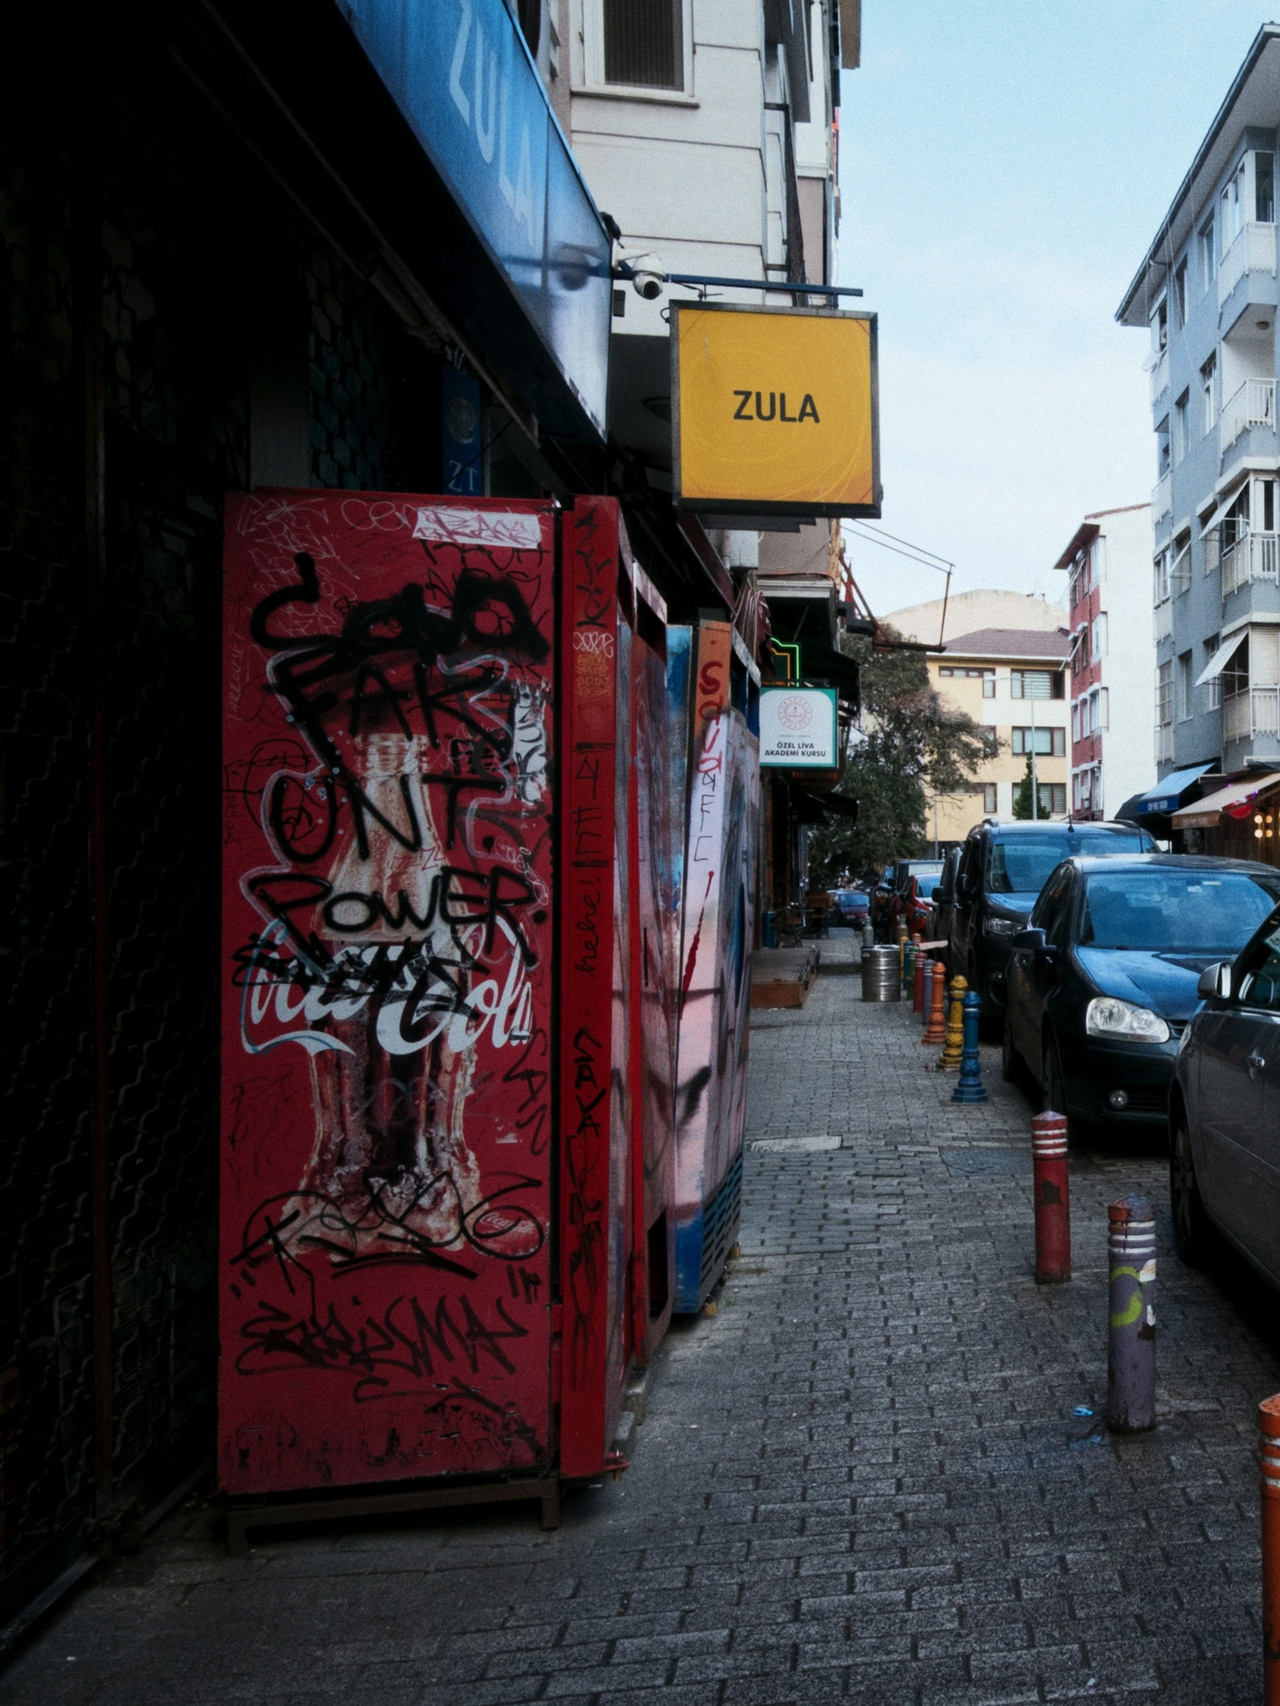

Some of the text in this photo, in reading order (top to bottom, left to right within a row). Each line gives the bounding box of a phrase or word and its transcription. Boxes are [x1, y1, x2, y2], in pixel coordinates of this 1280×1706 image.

[449, 0, 535, 250] ZULA
[733, 390, 821, 424] ZULA
[764, 748, 826, 757] AKADEMİ KURSU
[776, 741, 796, 749] ÖZEL
